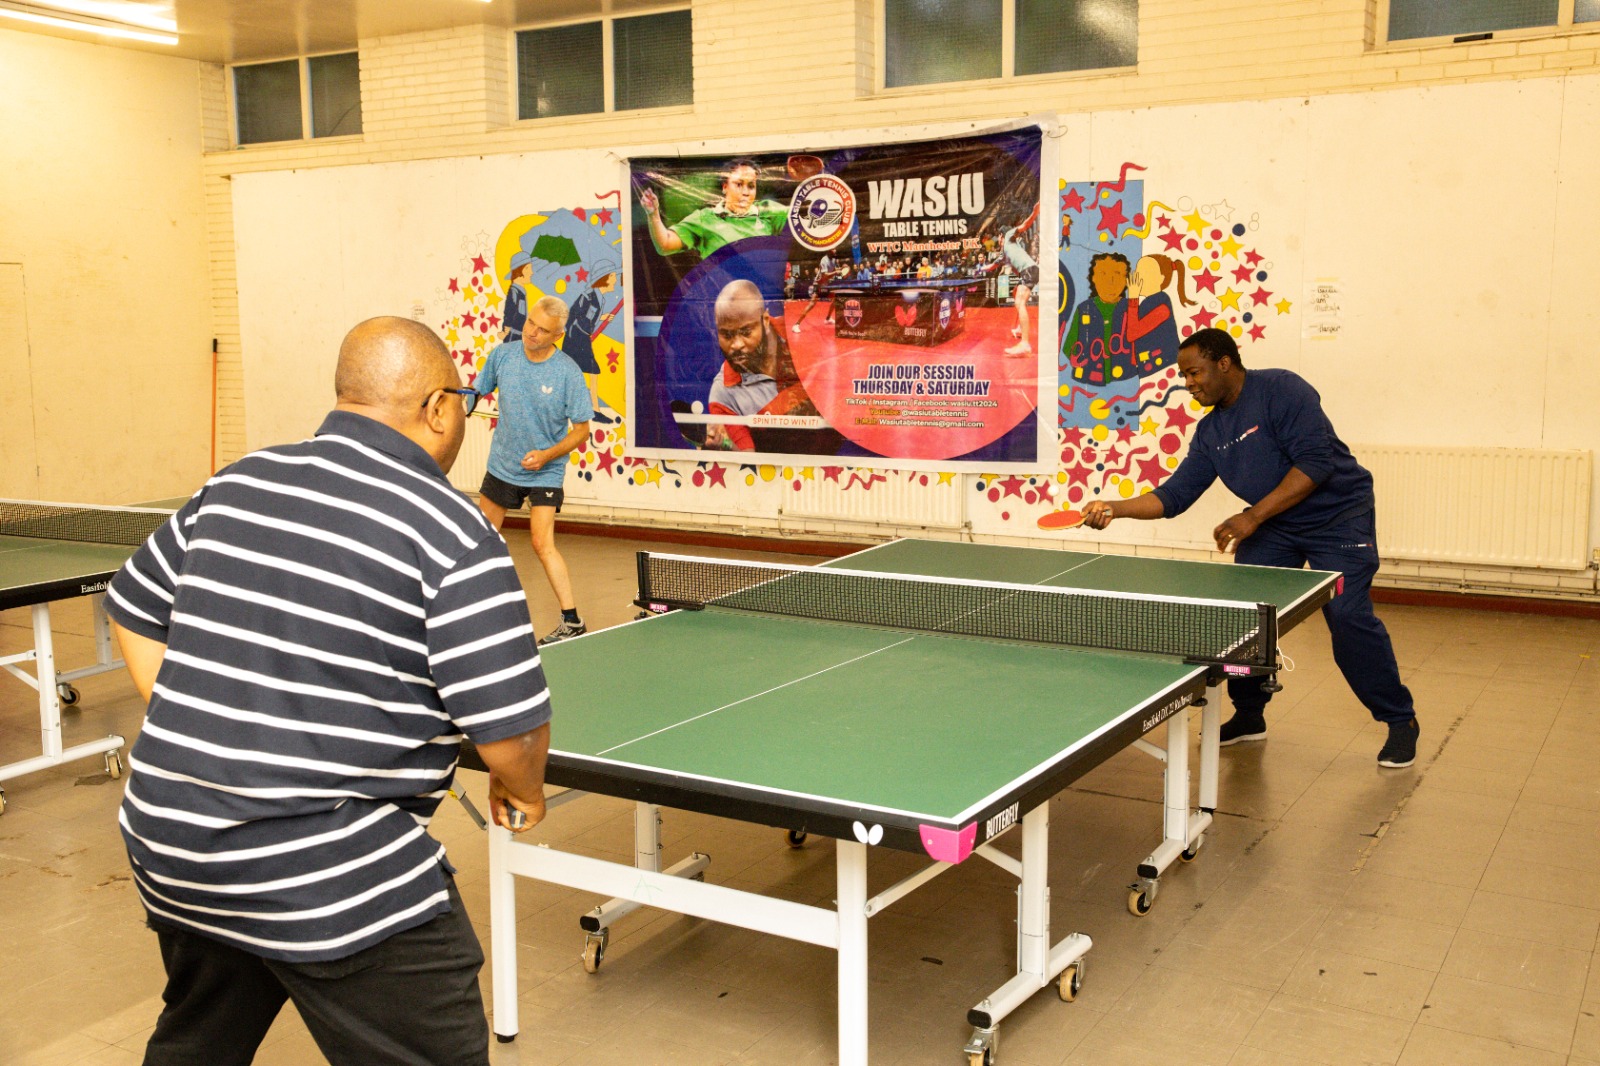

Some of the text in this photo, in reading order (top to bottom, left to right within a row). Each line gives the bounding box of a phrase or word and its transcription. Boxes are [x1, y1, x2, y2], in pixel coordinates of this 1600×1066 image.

[791, 179, 852, 226] WASIU TABLE TENNIS CLUB
[867, 172, 985, 219] WASIU
[882, 218, 968, 238] TABLE TENNIS
[867, 241, 901, 253] WTTC
[902, 240, 961, 252] Manchester
[868, 364, 974, 380] JOIN OUR SESSION
[853, 379, 990, 396] THURSDAY & SATURDAY
[872, 399, 909, 407] Instagram
[901, 409, 969, 417] @wasiutabletennis
[752, 417, 769, 425] SPIN
[779, 418, 790, 426] TO
[791, 419, 806, 427] WIN
[879, 418, 984, 428] Wasiutabletennis@gmail.com
[986, 801, 1019, 839] BUTTERFLY
